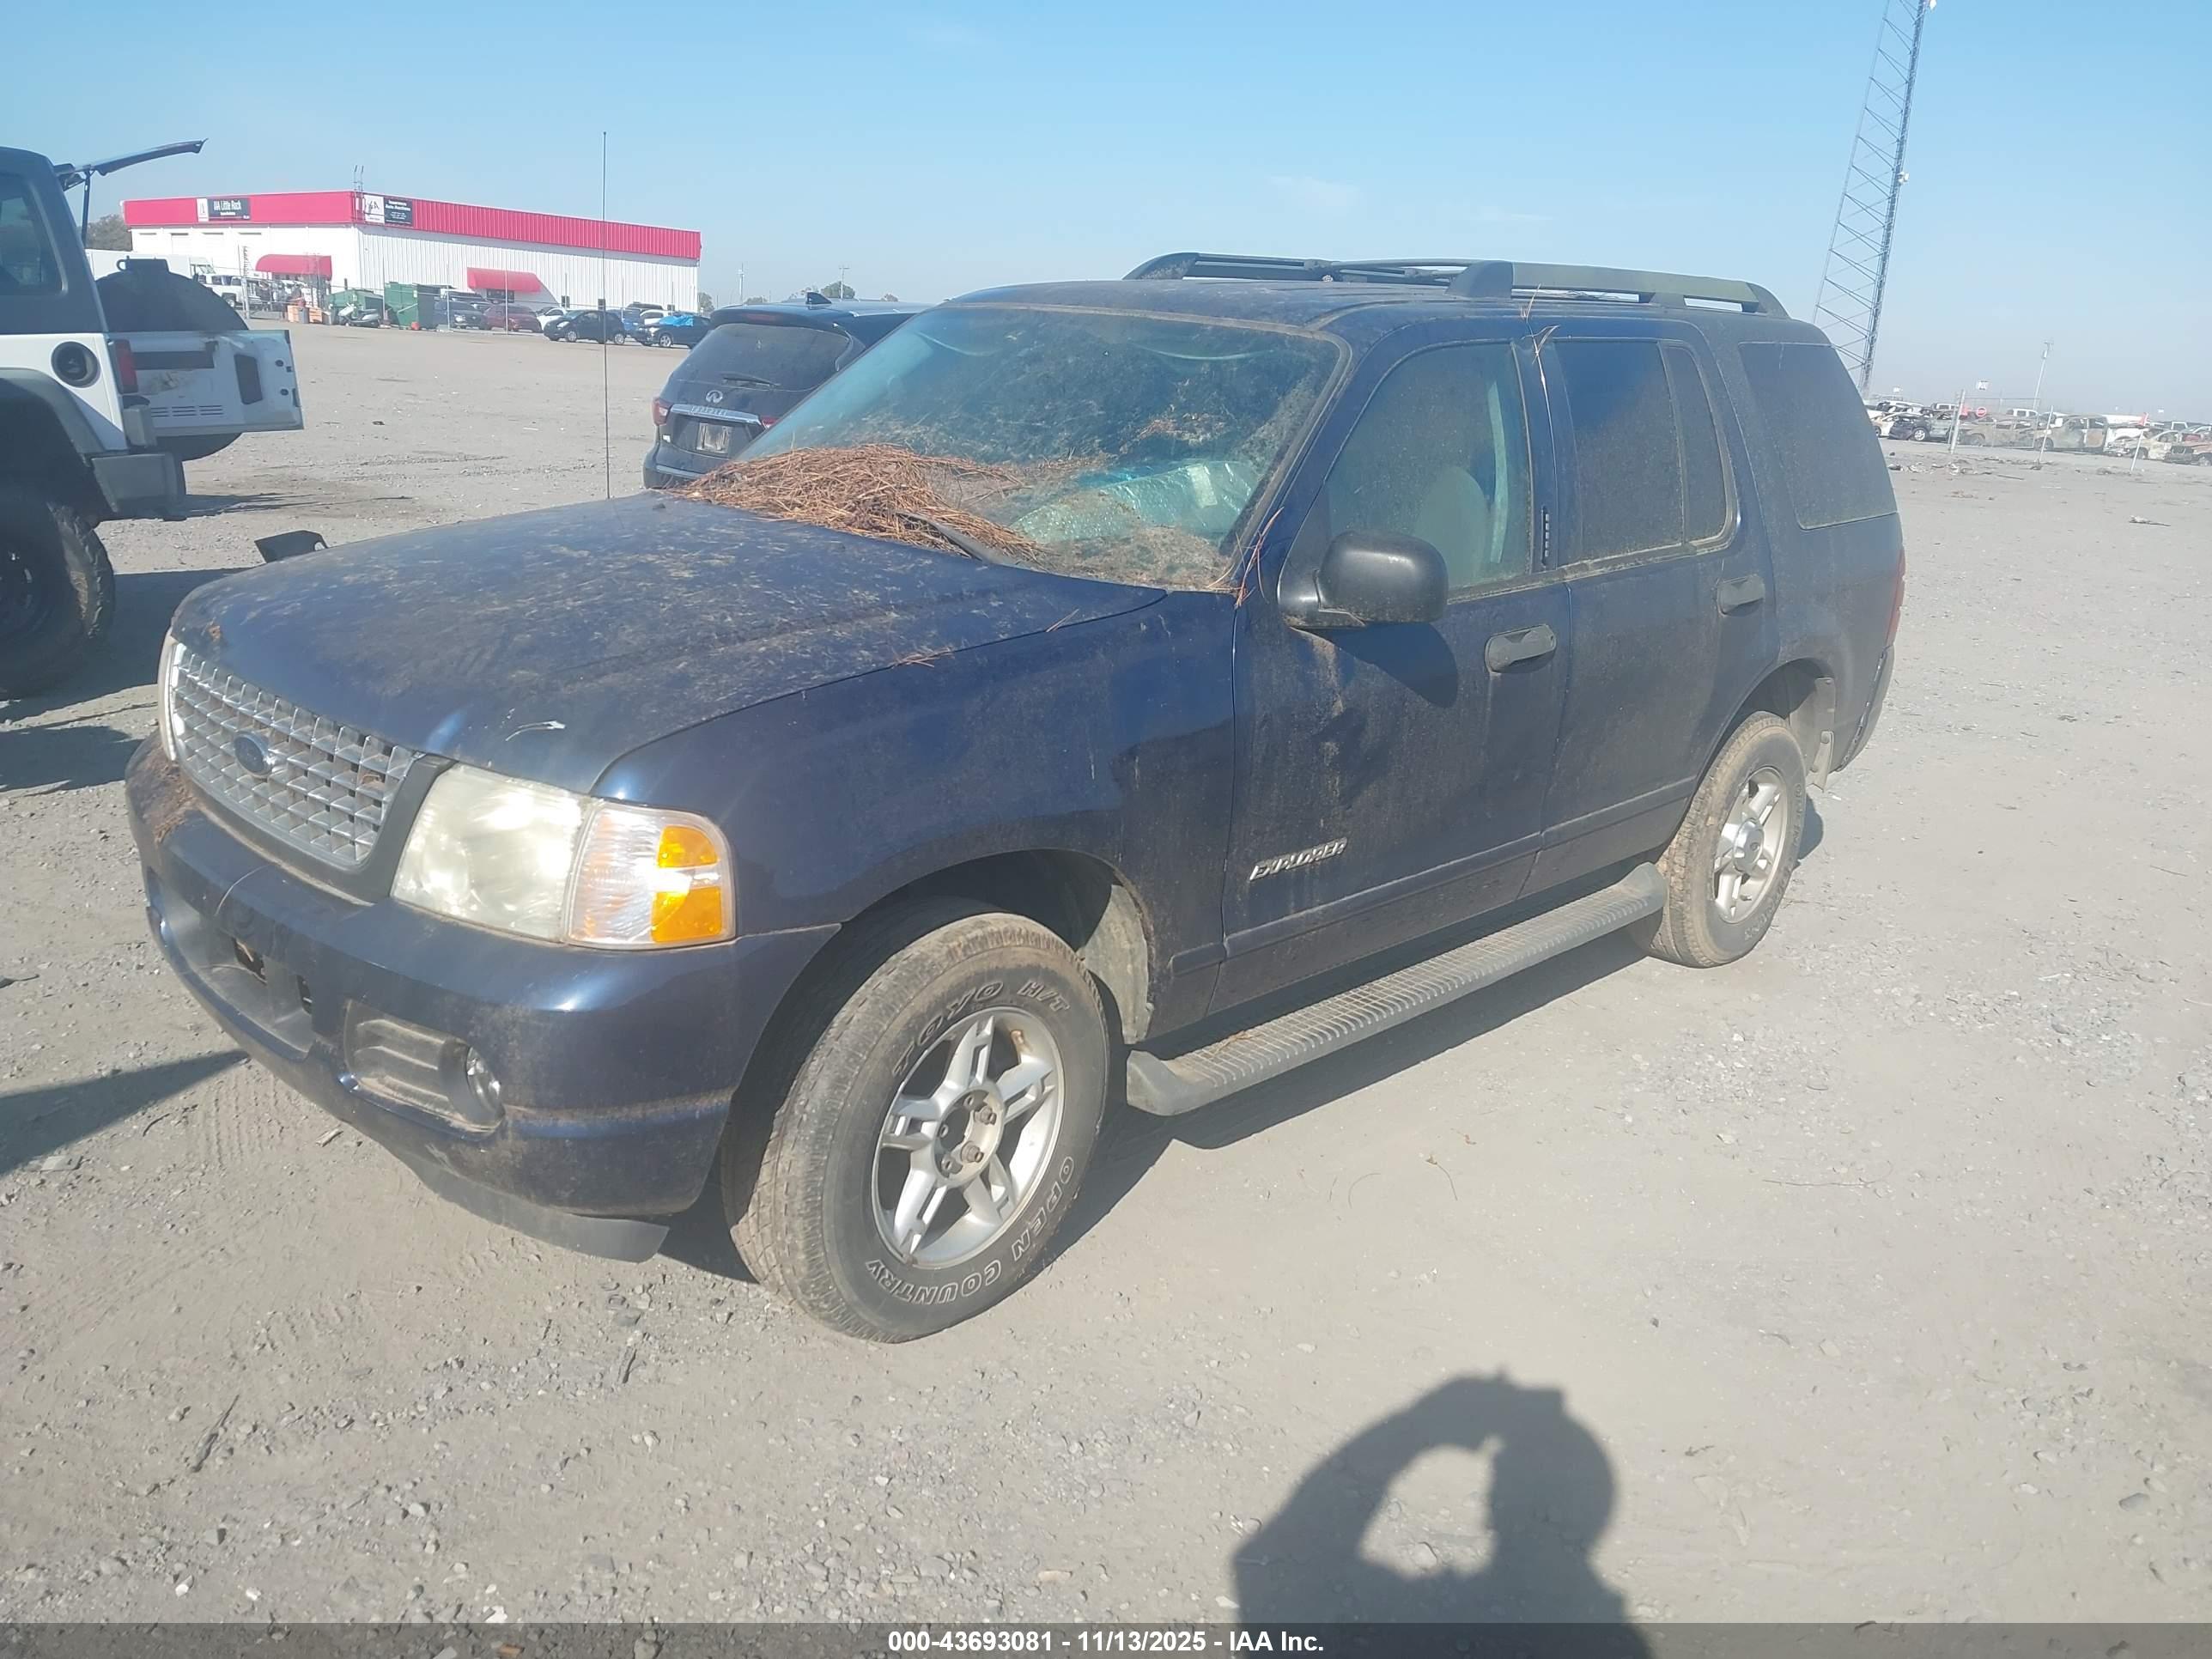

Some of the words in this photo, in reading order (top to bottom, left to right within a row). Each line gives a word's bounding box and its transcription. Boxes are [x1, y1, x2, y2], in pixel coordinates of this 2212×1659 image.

[891, 981, 1005, 1077] TOYO
[1017, 981, 1071, 1012] H/T
[1011, 1155, 1075, 1262] OPEN
[865, 1258, 1003, 1306] COUNTRY
